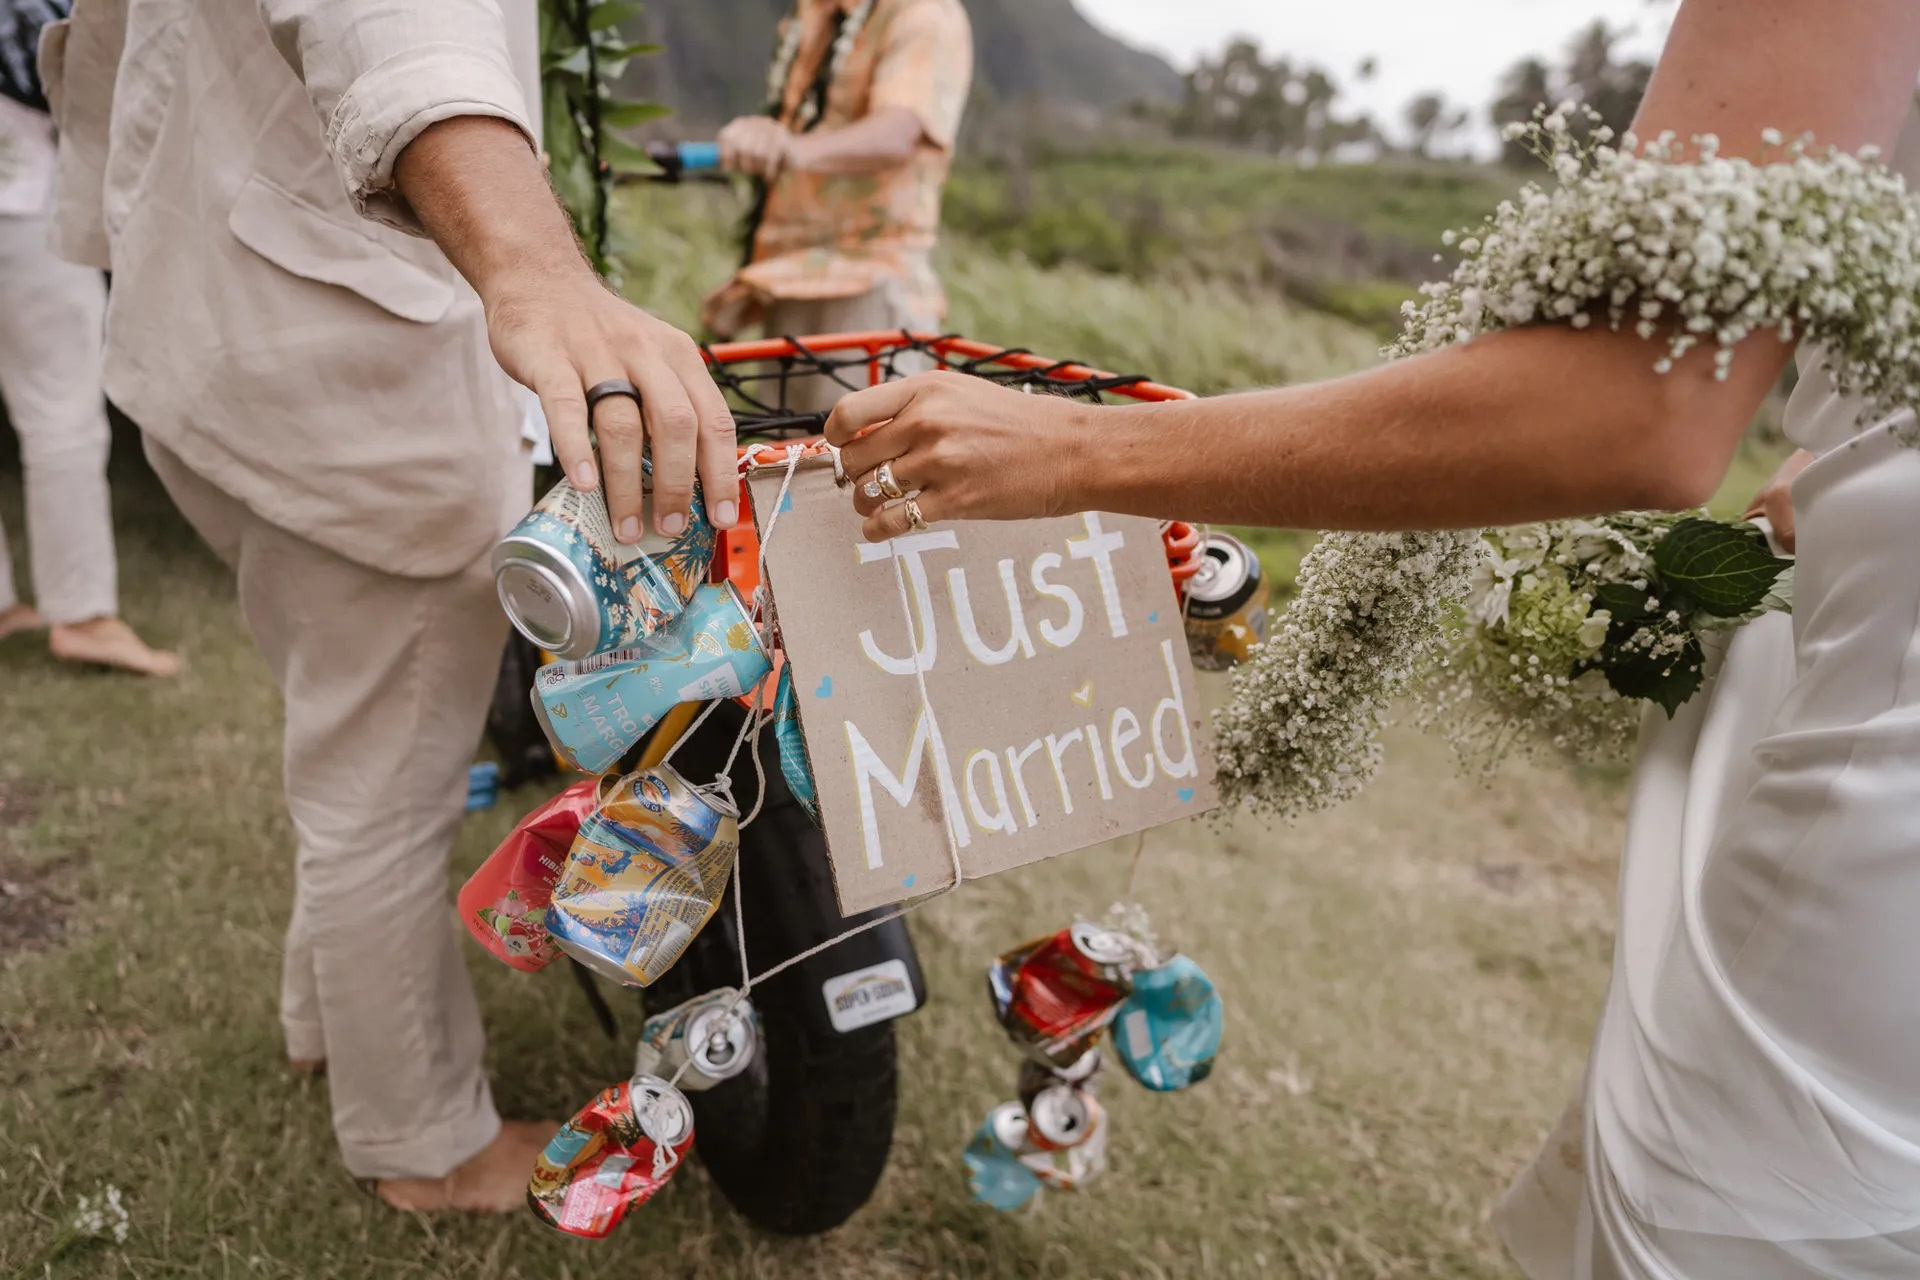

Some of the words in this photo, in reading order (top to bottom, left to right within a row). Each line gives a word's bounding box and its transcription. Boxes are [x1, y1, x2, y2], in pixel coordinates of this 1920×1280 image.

[854, 511, 1127, 675] Just
[713, 673, 735, 699] JUN
[607, 692, 645, 738] TRO
[844, 639, 1199, 870] Married
[634, 782, 651, 809] BREWING
[653, 779, 669, 795] KONA
[538, 854, 563, 876] HIBIS
